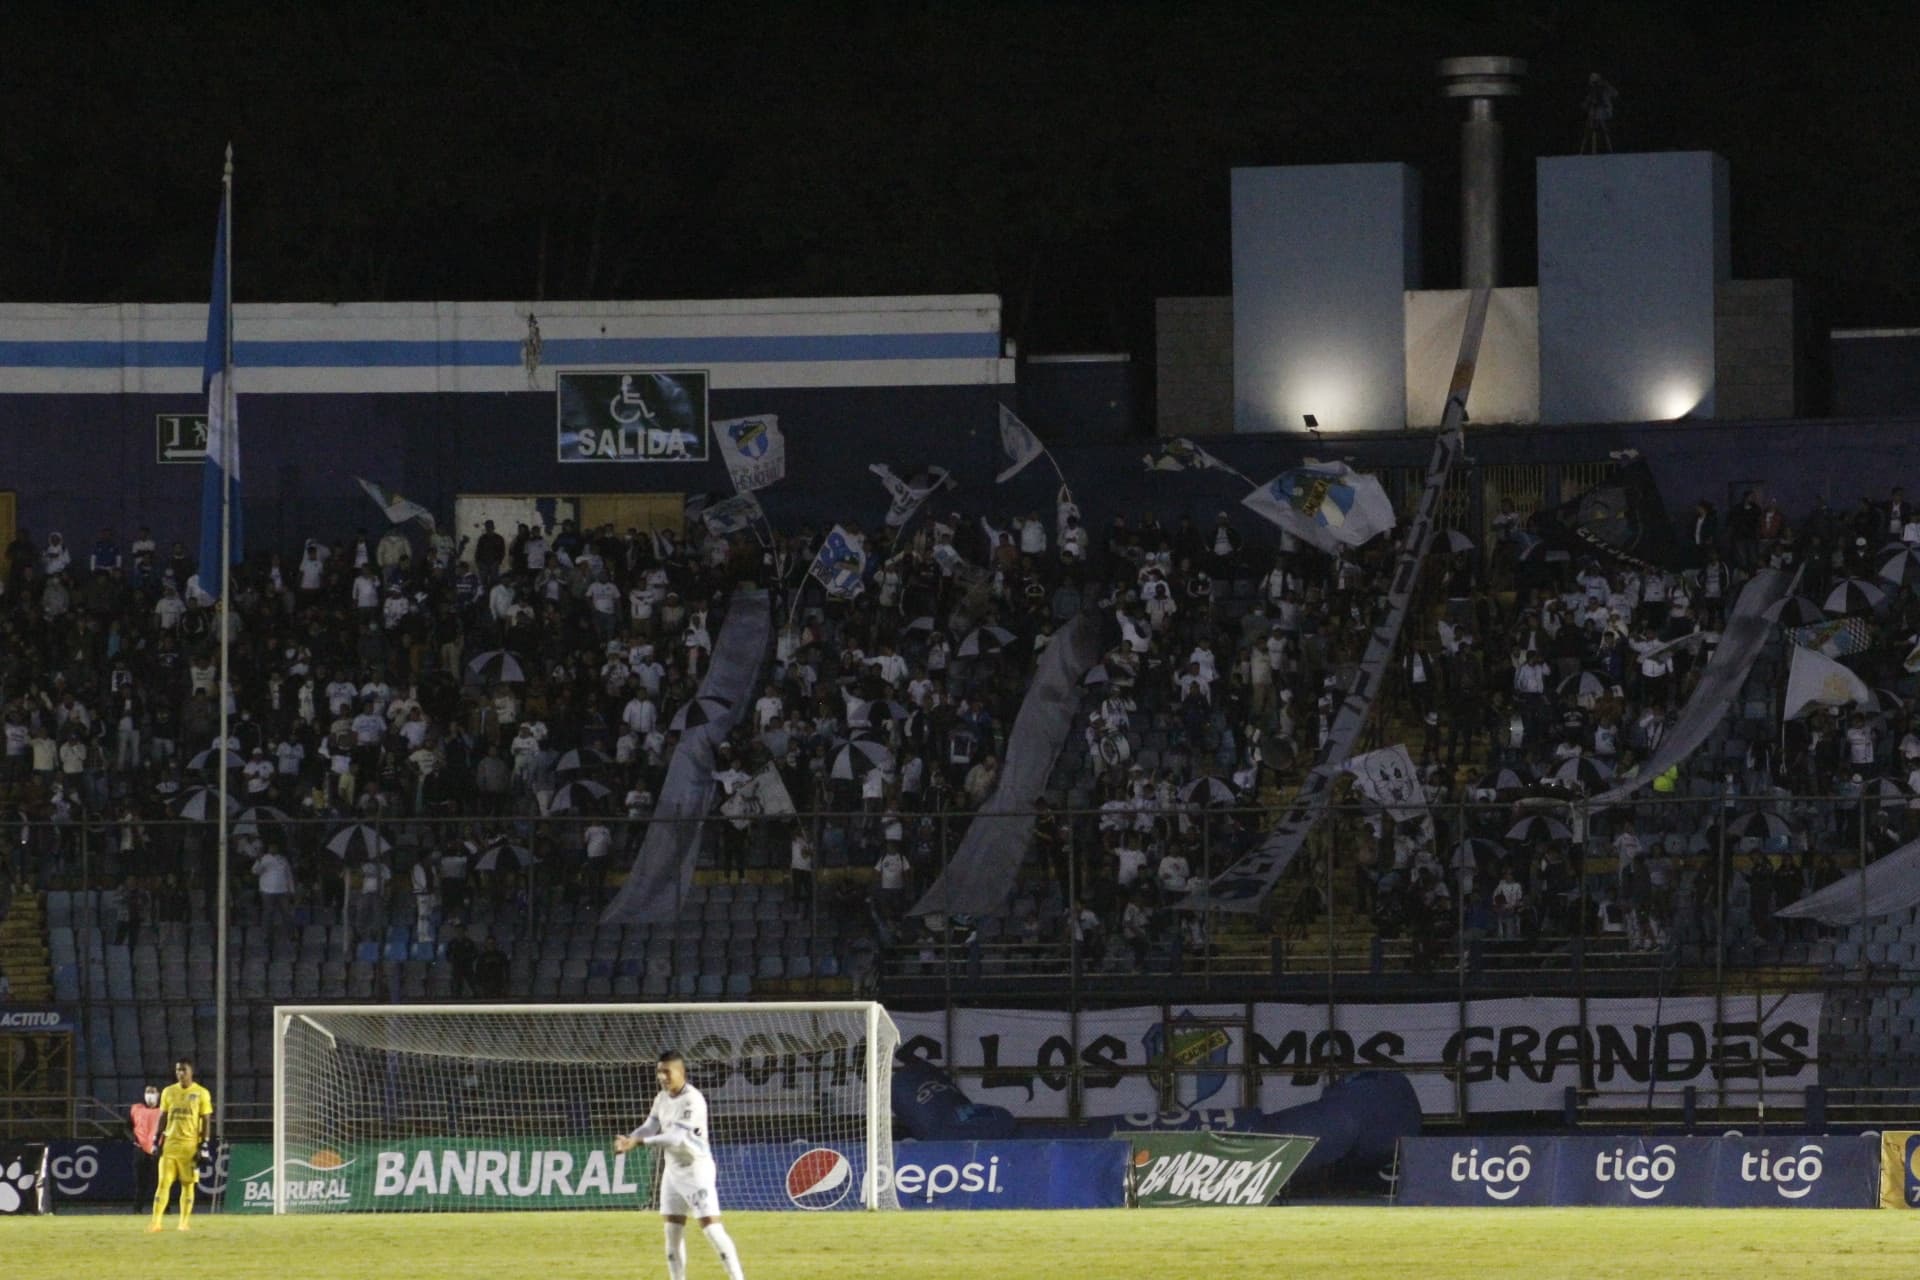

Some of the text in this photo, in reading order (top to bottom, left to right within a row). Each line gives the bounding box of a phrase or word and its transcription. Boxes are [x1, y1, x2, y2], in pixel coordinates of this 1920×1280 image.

[578, 428, 687, 456] SALIDA
[0, 1012, 60, 1026] ACTITUD
[979, 1034, 1127, 1102] LOS
[1442, 1021, 1809, 1097] GRANDES
[244, 1179, 352, 1201] BARURAL
[374, 1150, 638, 1197] BANRURAL
[1137, 1151, 1282, 1205] BANRURAL
